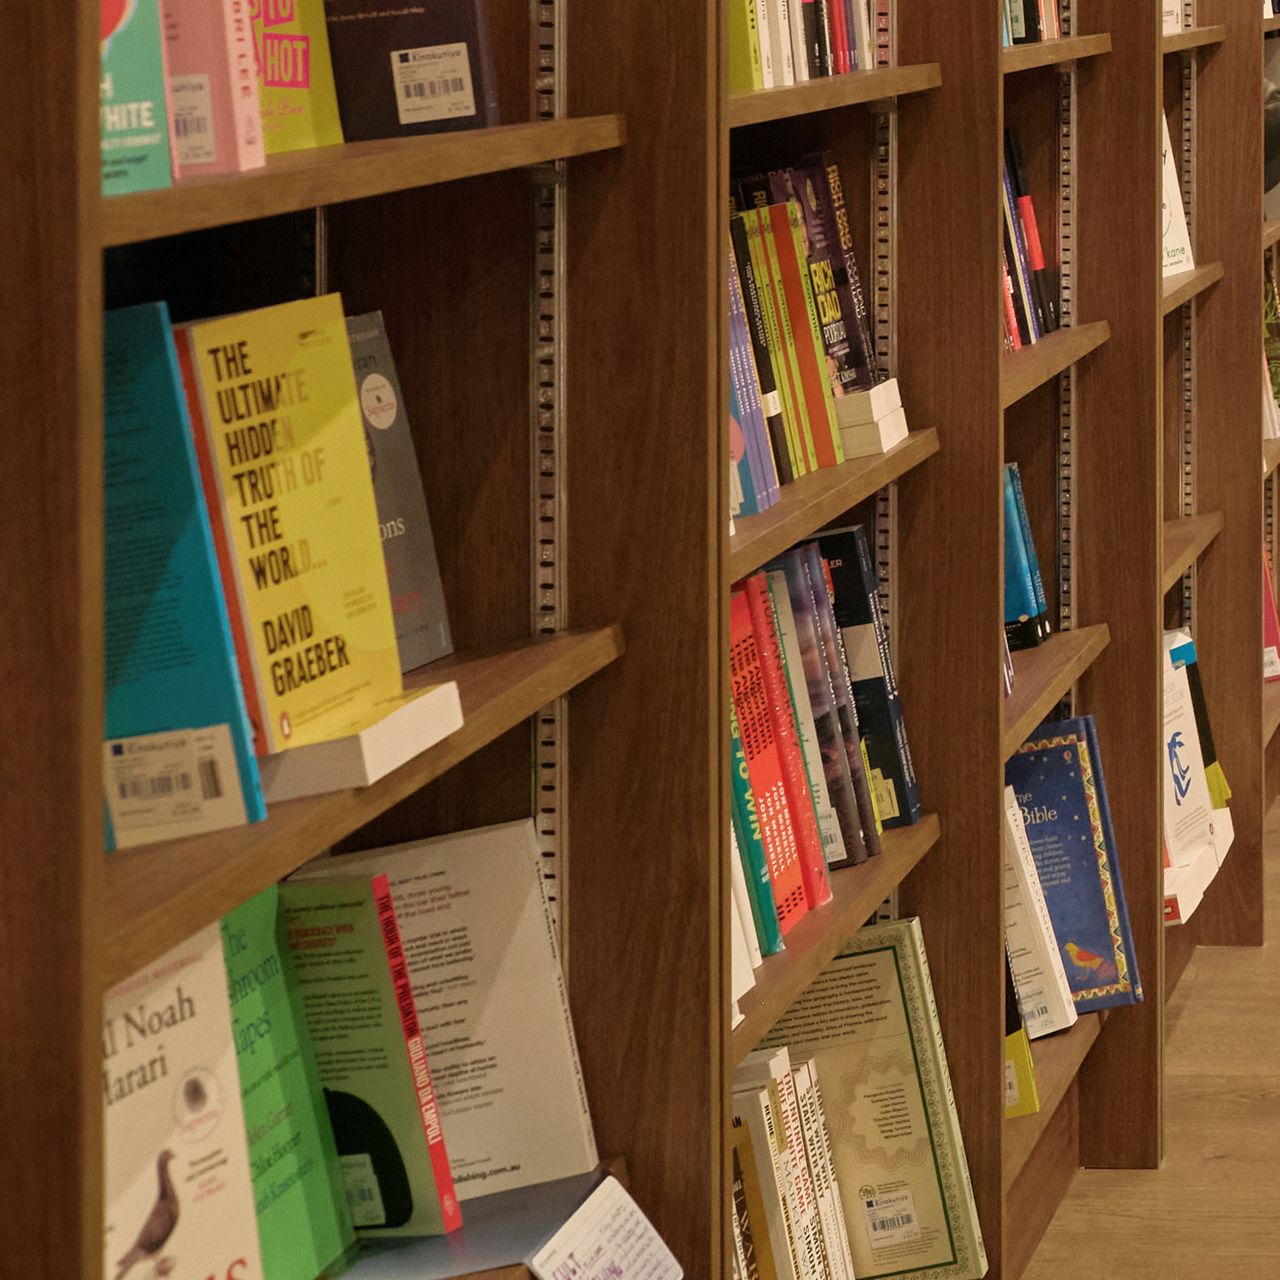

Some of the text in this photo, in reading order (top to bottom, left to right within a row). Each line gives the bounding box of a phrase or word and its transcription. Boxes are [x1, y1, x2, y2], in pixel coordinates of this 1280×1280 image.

[265, 39, 308, 83] HOT
[810, 260, 835, 294] RICH
[803, 273, 820, 341] Economics
[816, 290, 841, 326] DAD
[206, 340, 253, 382] THE
[216, 367, 310, 425] ULTIMATE
[224, 417, 295, 467] HIDDEN
[240, 505, 282, 549] THE
[262, 603, 314, 657] DAVID
[269, 633, 350, 698] GRAEBER
[123, 986, 197, 1050] Noah
[422, 1106, 443, 1145] EMPOLI
[801, 1092, 812, 1131] START
